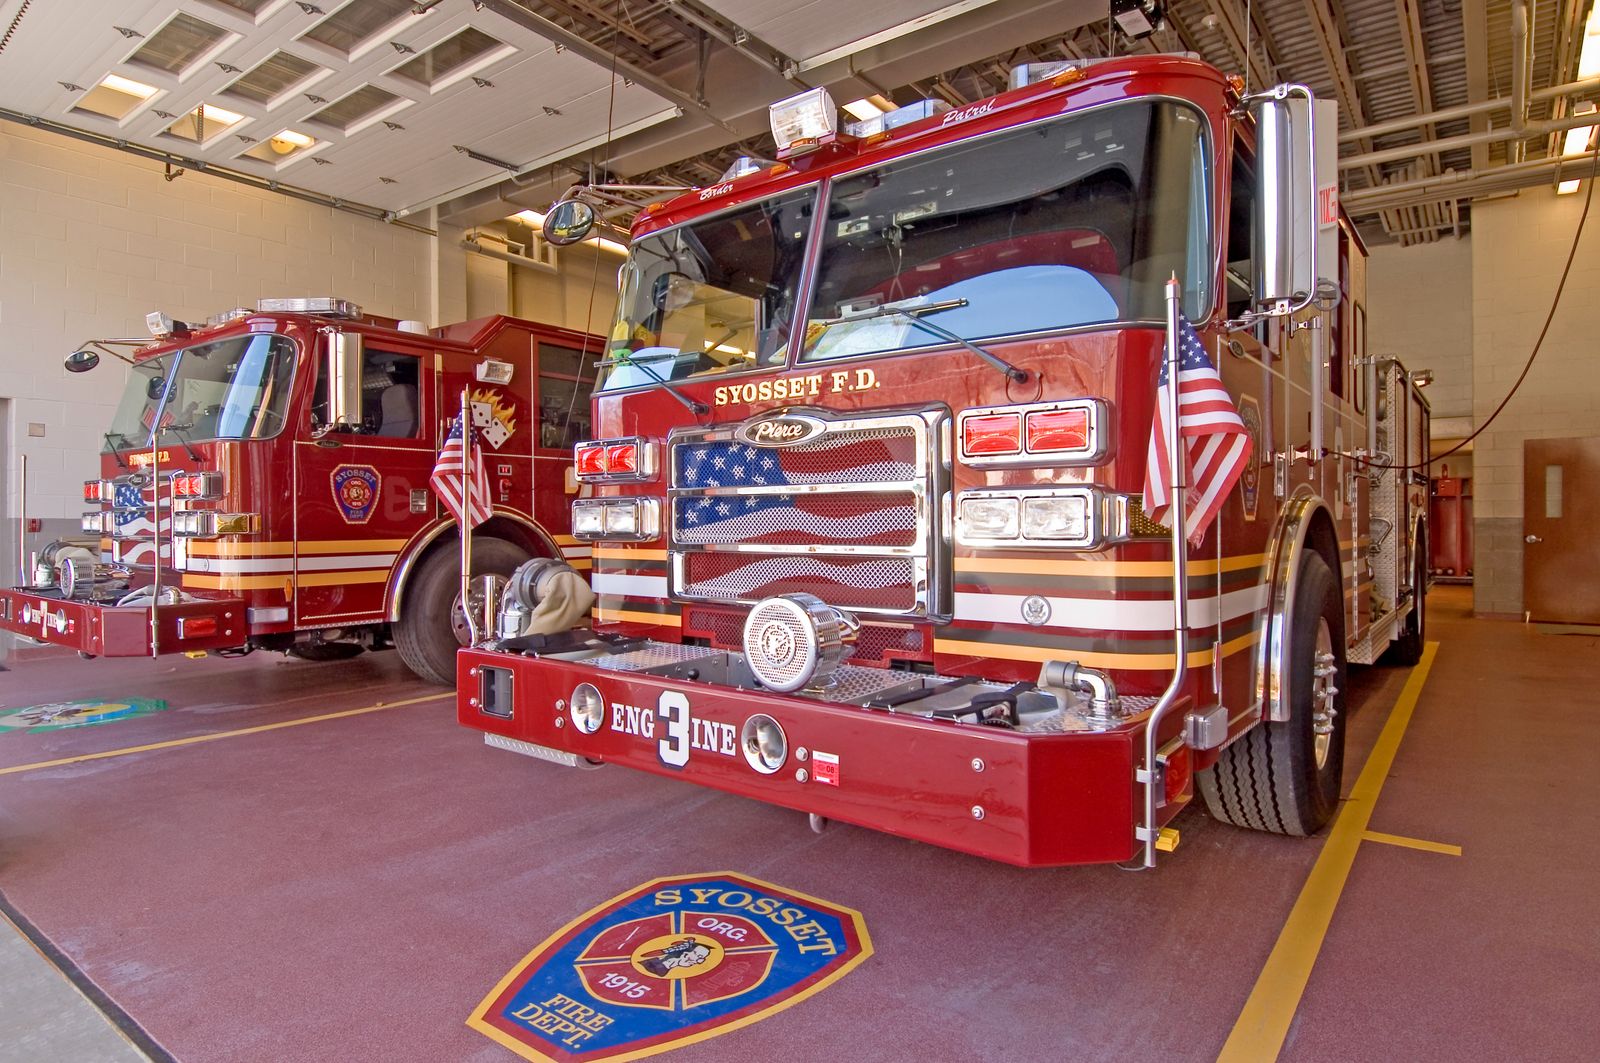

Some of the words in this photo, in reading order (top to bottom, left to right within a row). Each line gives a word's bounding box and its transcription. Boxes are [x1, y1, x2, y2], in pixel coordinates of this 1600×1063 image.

[699, 184, 733, 200] Border
[941, 98, 996, 128] Patrol
[715, 374, 822, 405] SYOSSET
[831, 368, 881, 393] F.D.
[755, 421, 803, 442] Pierce
[335, 469, 376, 483] SYOSSET
[611, 702, 655, 739] ENG
[657, 690, 690, 768] 3
[691, 717, 737, 757] INE
[655, 888, 837, 956] SYOSSET
[697, 917, 748, 942] ORG.
[598, 972, 652, 998] 1915
[512, 1002, 594, 1049] DEPT.
[540, 993, 616, 1032] FIRE
